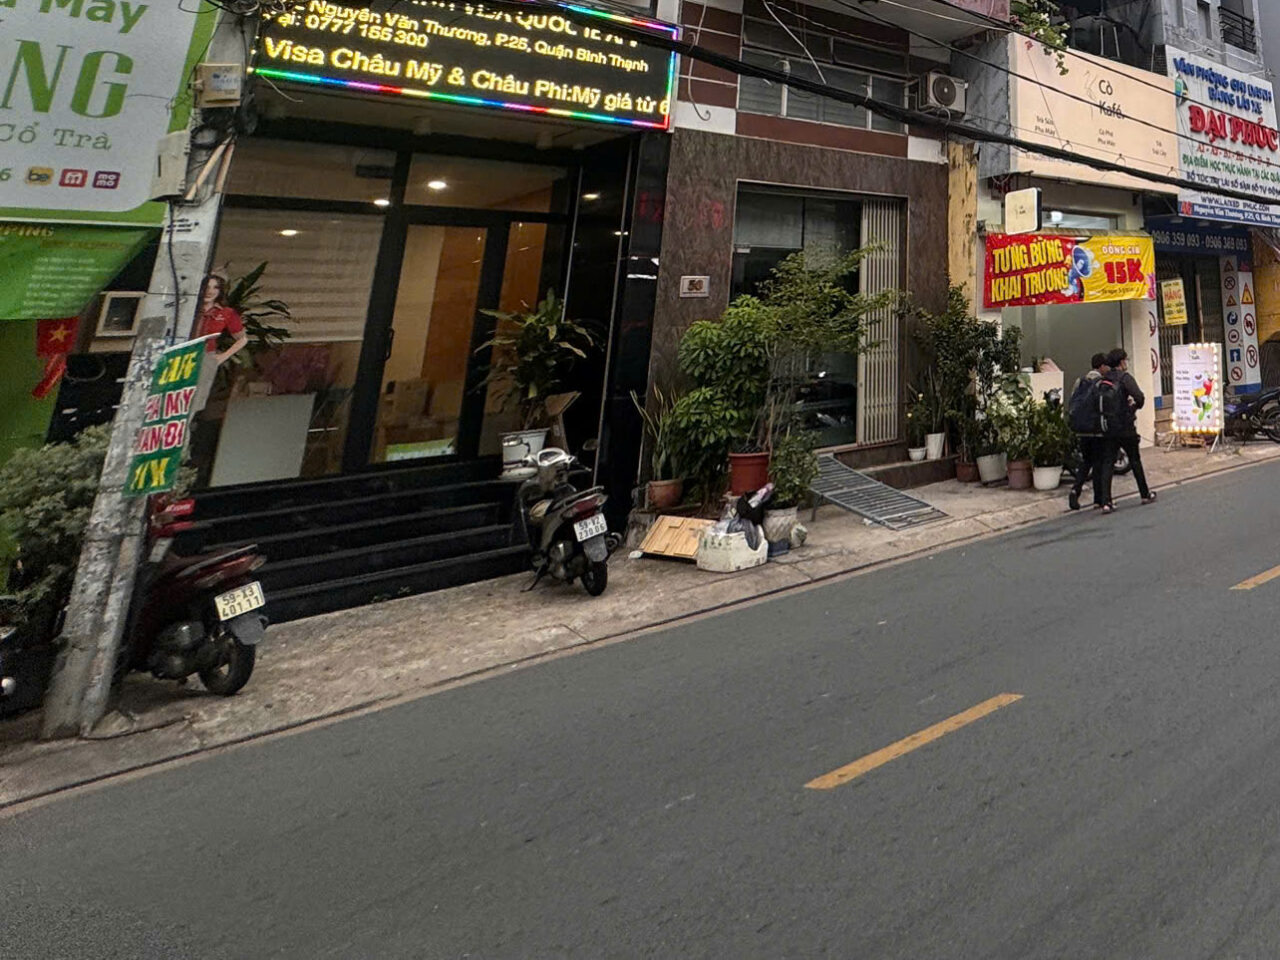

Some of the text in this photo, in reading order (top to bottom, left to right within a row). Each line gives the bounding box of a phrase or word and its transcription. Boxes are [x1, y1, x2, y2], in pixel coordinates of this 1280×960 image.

[306, 14, 355, 34] 0777
[393, 29, 430, 48] 300
[385, 12, 418, 30] Văn
[534, 40, 573, 60] Quận
[609, 54, 650, 73] Thạnh
[0, 39, 134, 119] NG
[265, 37, 325, 64] Visa
[331, 47, 400, 77] Châu
[406, 59, 443, 86] Mỹ
[449, 67, 466, 86] &
[472, 70, 529, 95] Châu
[604, 93, 632, 111] giá
[636, 95, 656, 113] từ
[53, 127, 113, 151] Trà
[1188, 105, 1279, 152] ĐẠI PHÚC
[28, 170, 50, 182] be
[1030, 237, 1063, 266] BỪNG
[991, 267, 1069, 302] KHAI TRƯƠNG
[1104, 258, 1145, 284] 15K
[222, 586, 254, 606] 59-X3
